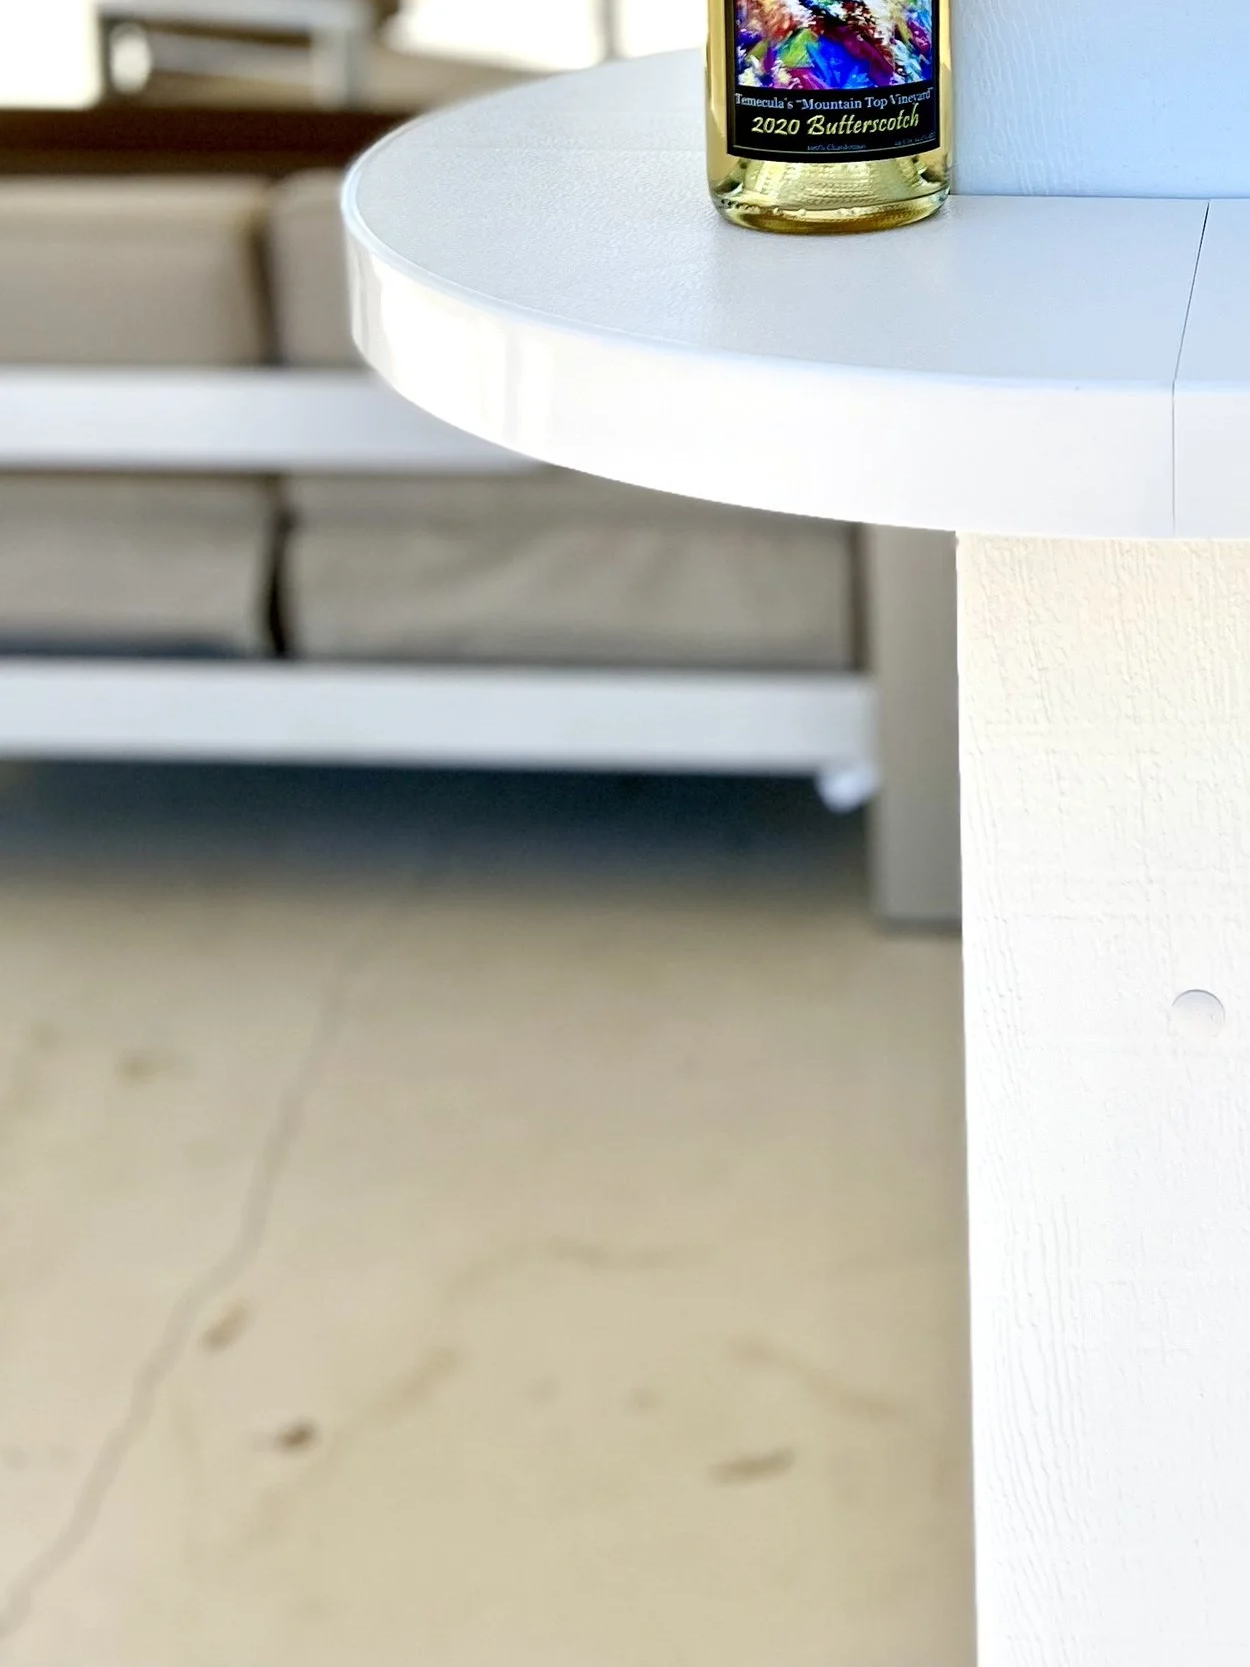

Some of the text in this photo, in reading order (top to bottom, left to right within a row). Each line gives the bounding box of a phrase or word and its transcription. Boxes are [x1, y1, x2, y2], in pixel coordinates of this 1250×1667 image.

[735, 93, 793, 109] Temecula's
[864, 96, 888, 109] Top
[751, 103, 919, 135] 2020 Butterscotch
